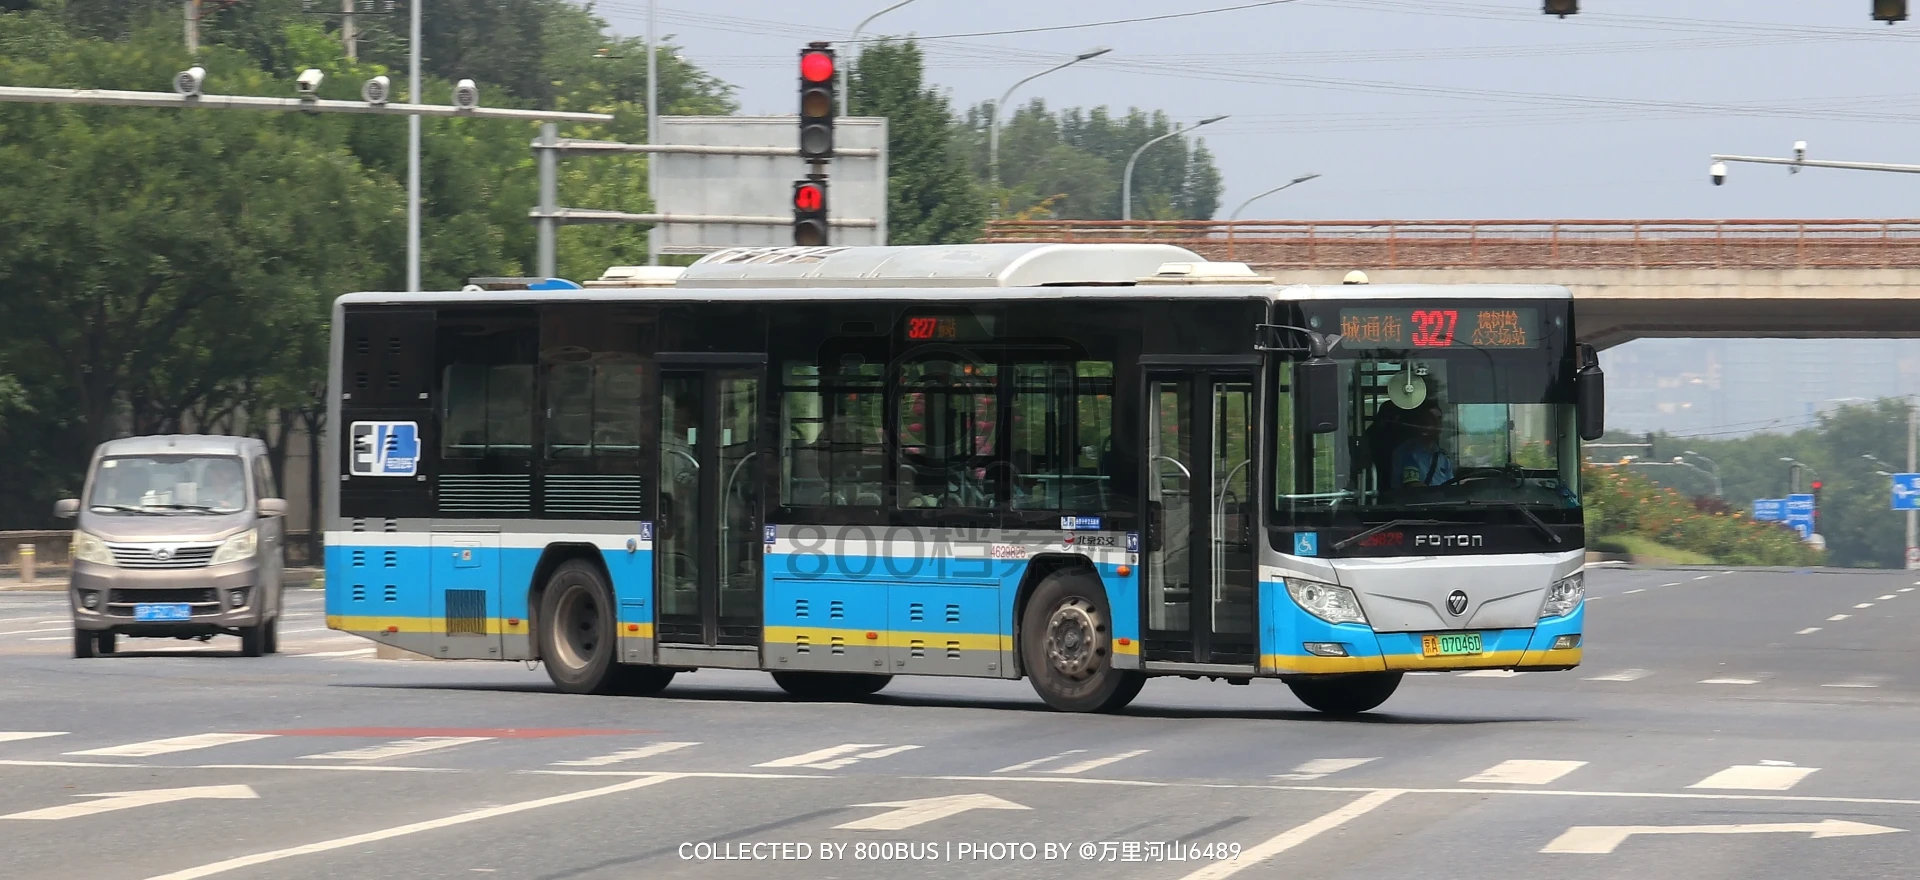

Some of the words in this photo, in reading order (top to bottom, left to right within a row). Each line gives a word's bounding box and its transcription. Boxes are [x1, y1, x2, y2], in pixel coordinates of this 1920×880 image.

[908, 317, 937, 339] 327
[1341, 315, 1402, 342] 城通街
[1411, 310, 1458, 347] 327
[1472, 327, 1526, 346] 公交场站
[1077, 535, 1115, 546] 北京公交
[1415, 534, 1483, 547] FOTON
[990, 545, 1026, 558] 4629826
